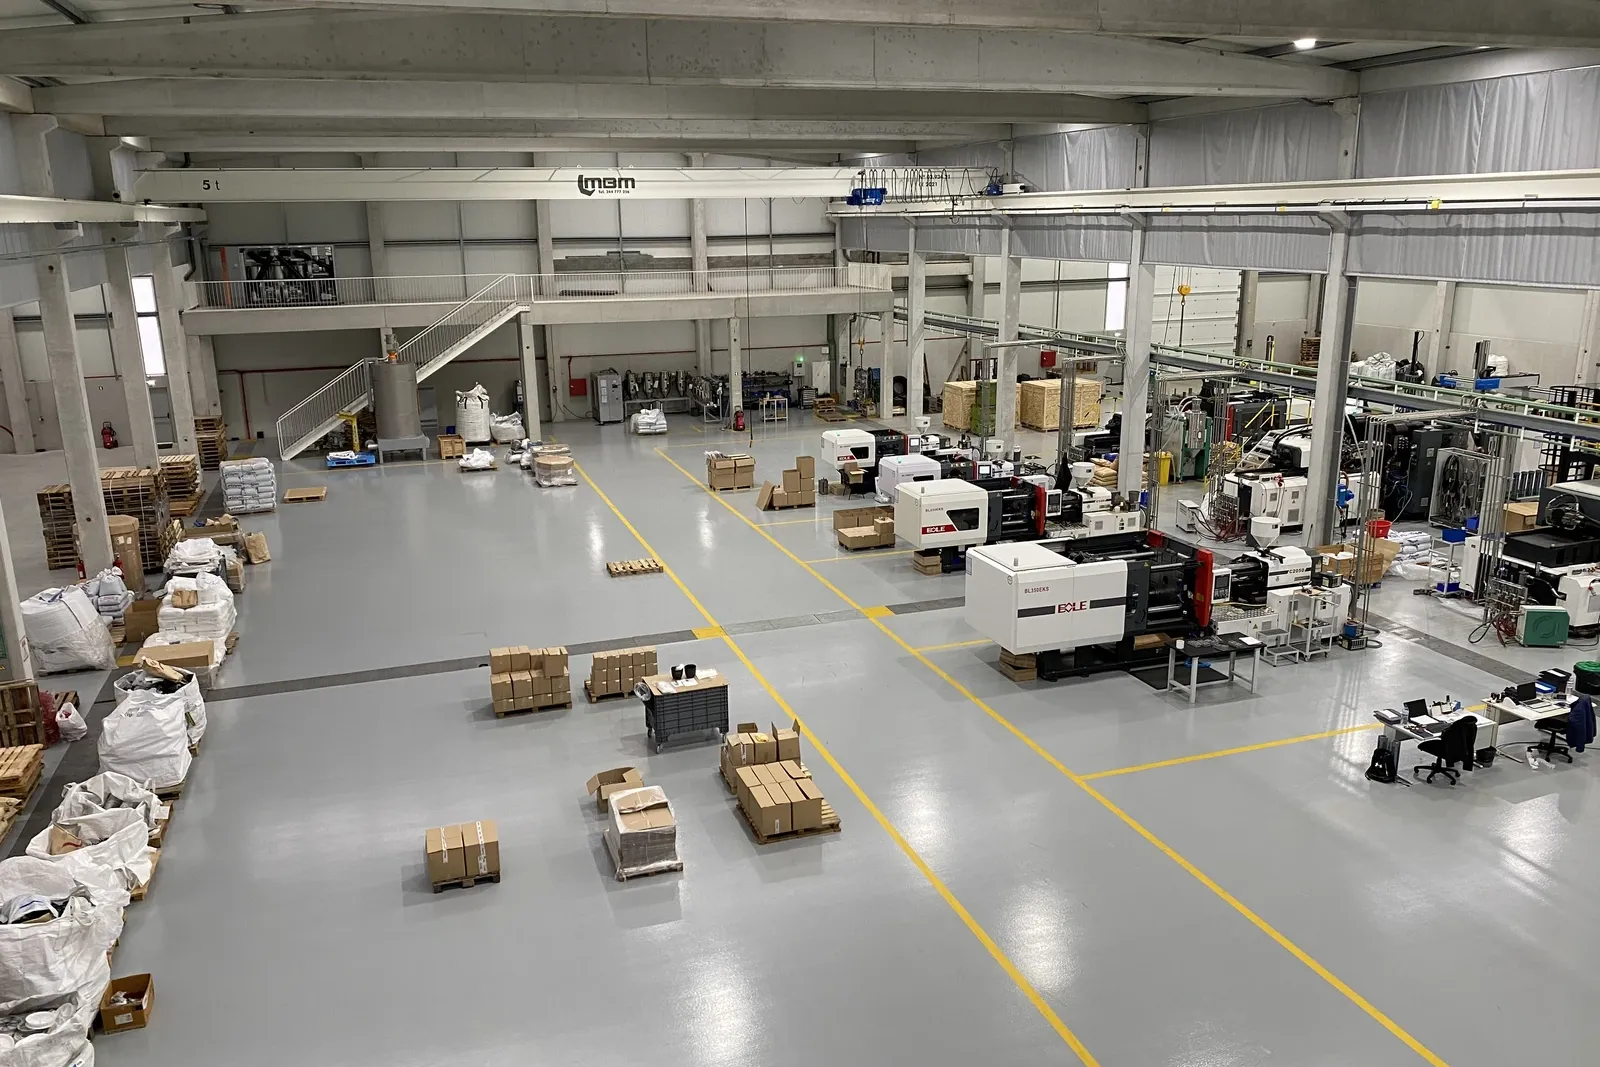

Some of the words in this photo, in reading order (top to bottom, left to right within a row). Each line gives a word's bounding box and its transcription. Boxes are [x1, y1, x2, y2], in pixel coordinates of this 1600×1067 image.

[202, 180, 210, 190] 5
[215, 180, 220, 190] t
[1058, 601, 1087, 613] EOLE
